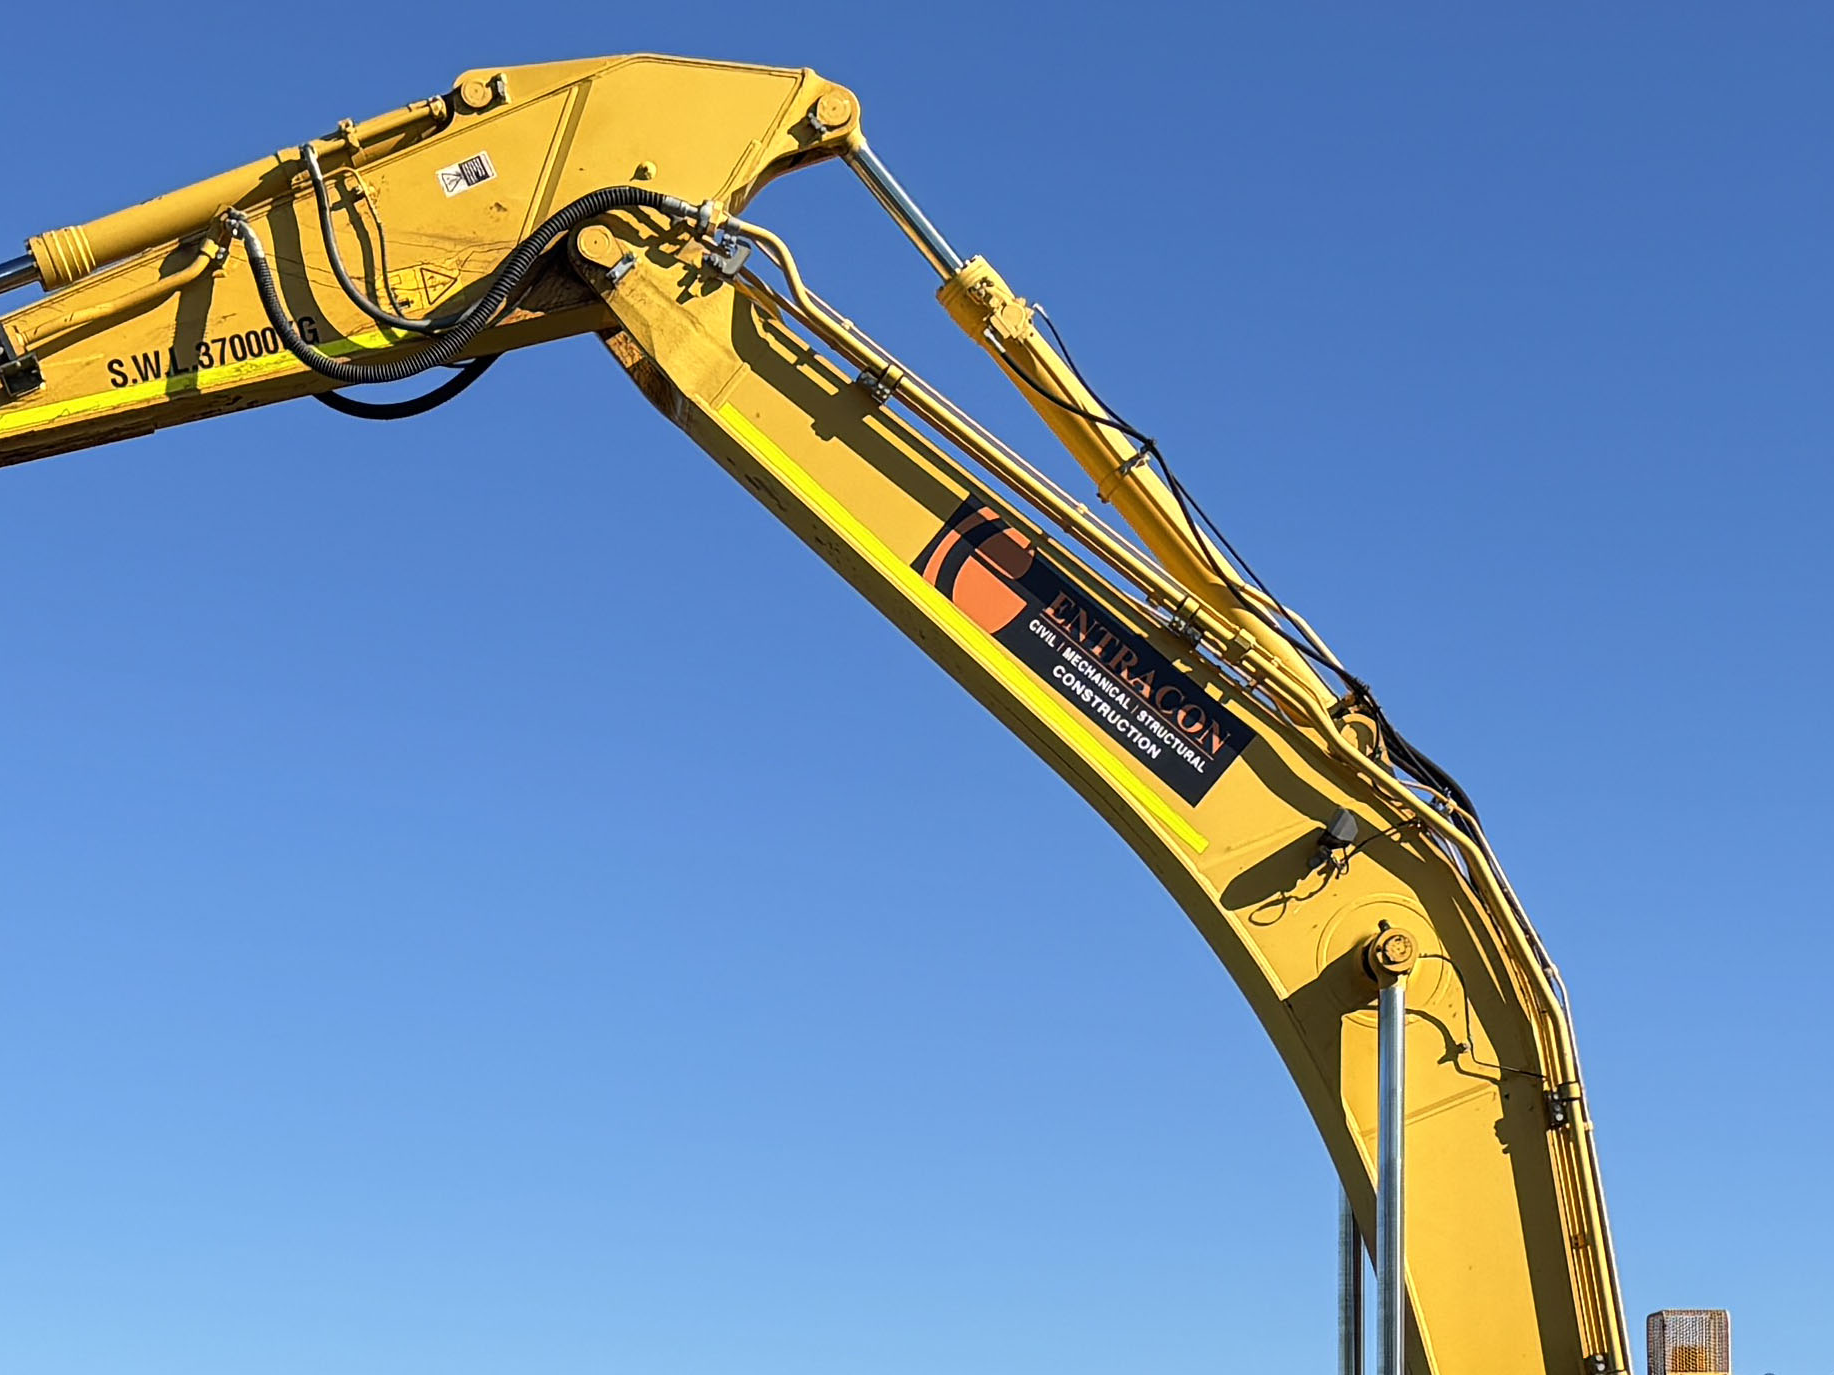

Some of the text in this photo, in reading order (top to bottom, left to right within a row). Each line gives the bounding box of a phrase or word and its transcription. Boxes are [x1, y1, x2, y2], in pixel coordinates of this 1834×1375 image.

[106, 315, 319, 389] S.W.L.37000G
[1028, 618, 1206, 774] CIVIL MECHANICAL STRUCTURAL
[1043, 589, 1233, 756] ENTRACON
[1052, 663, 1161, 760] CONSTRUCTION
